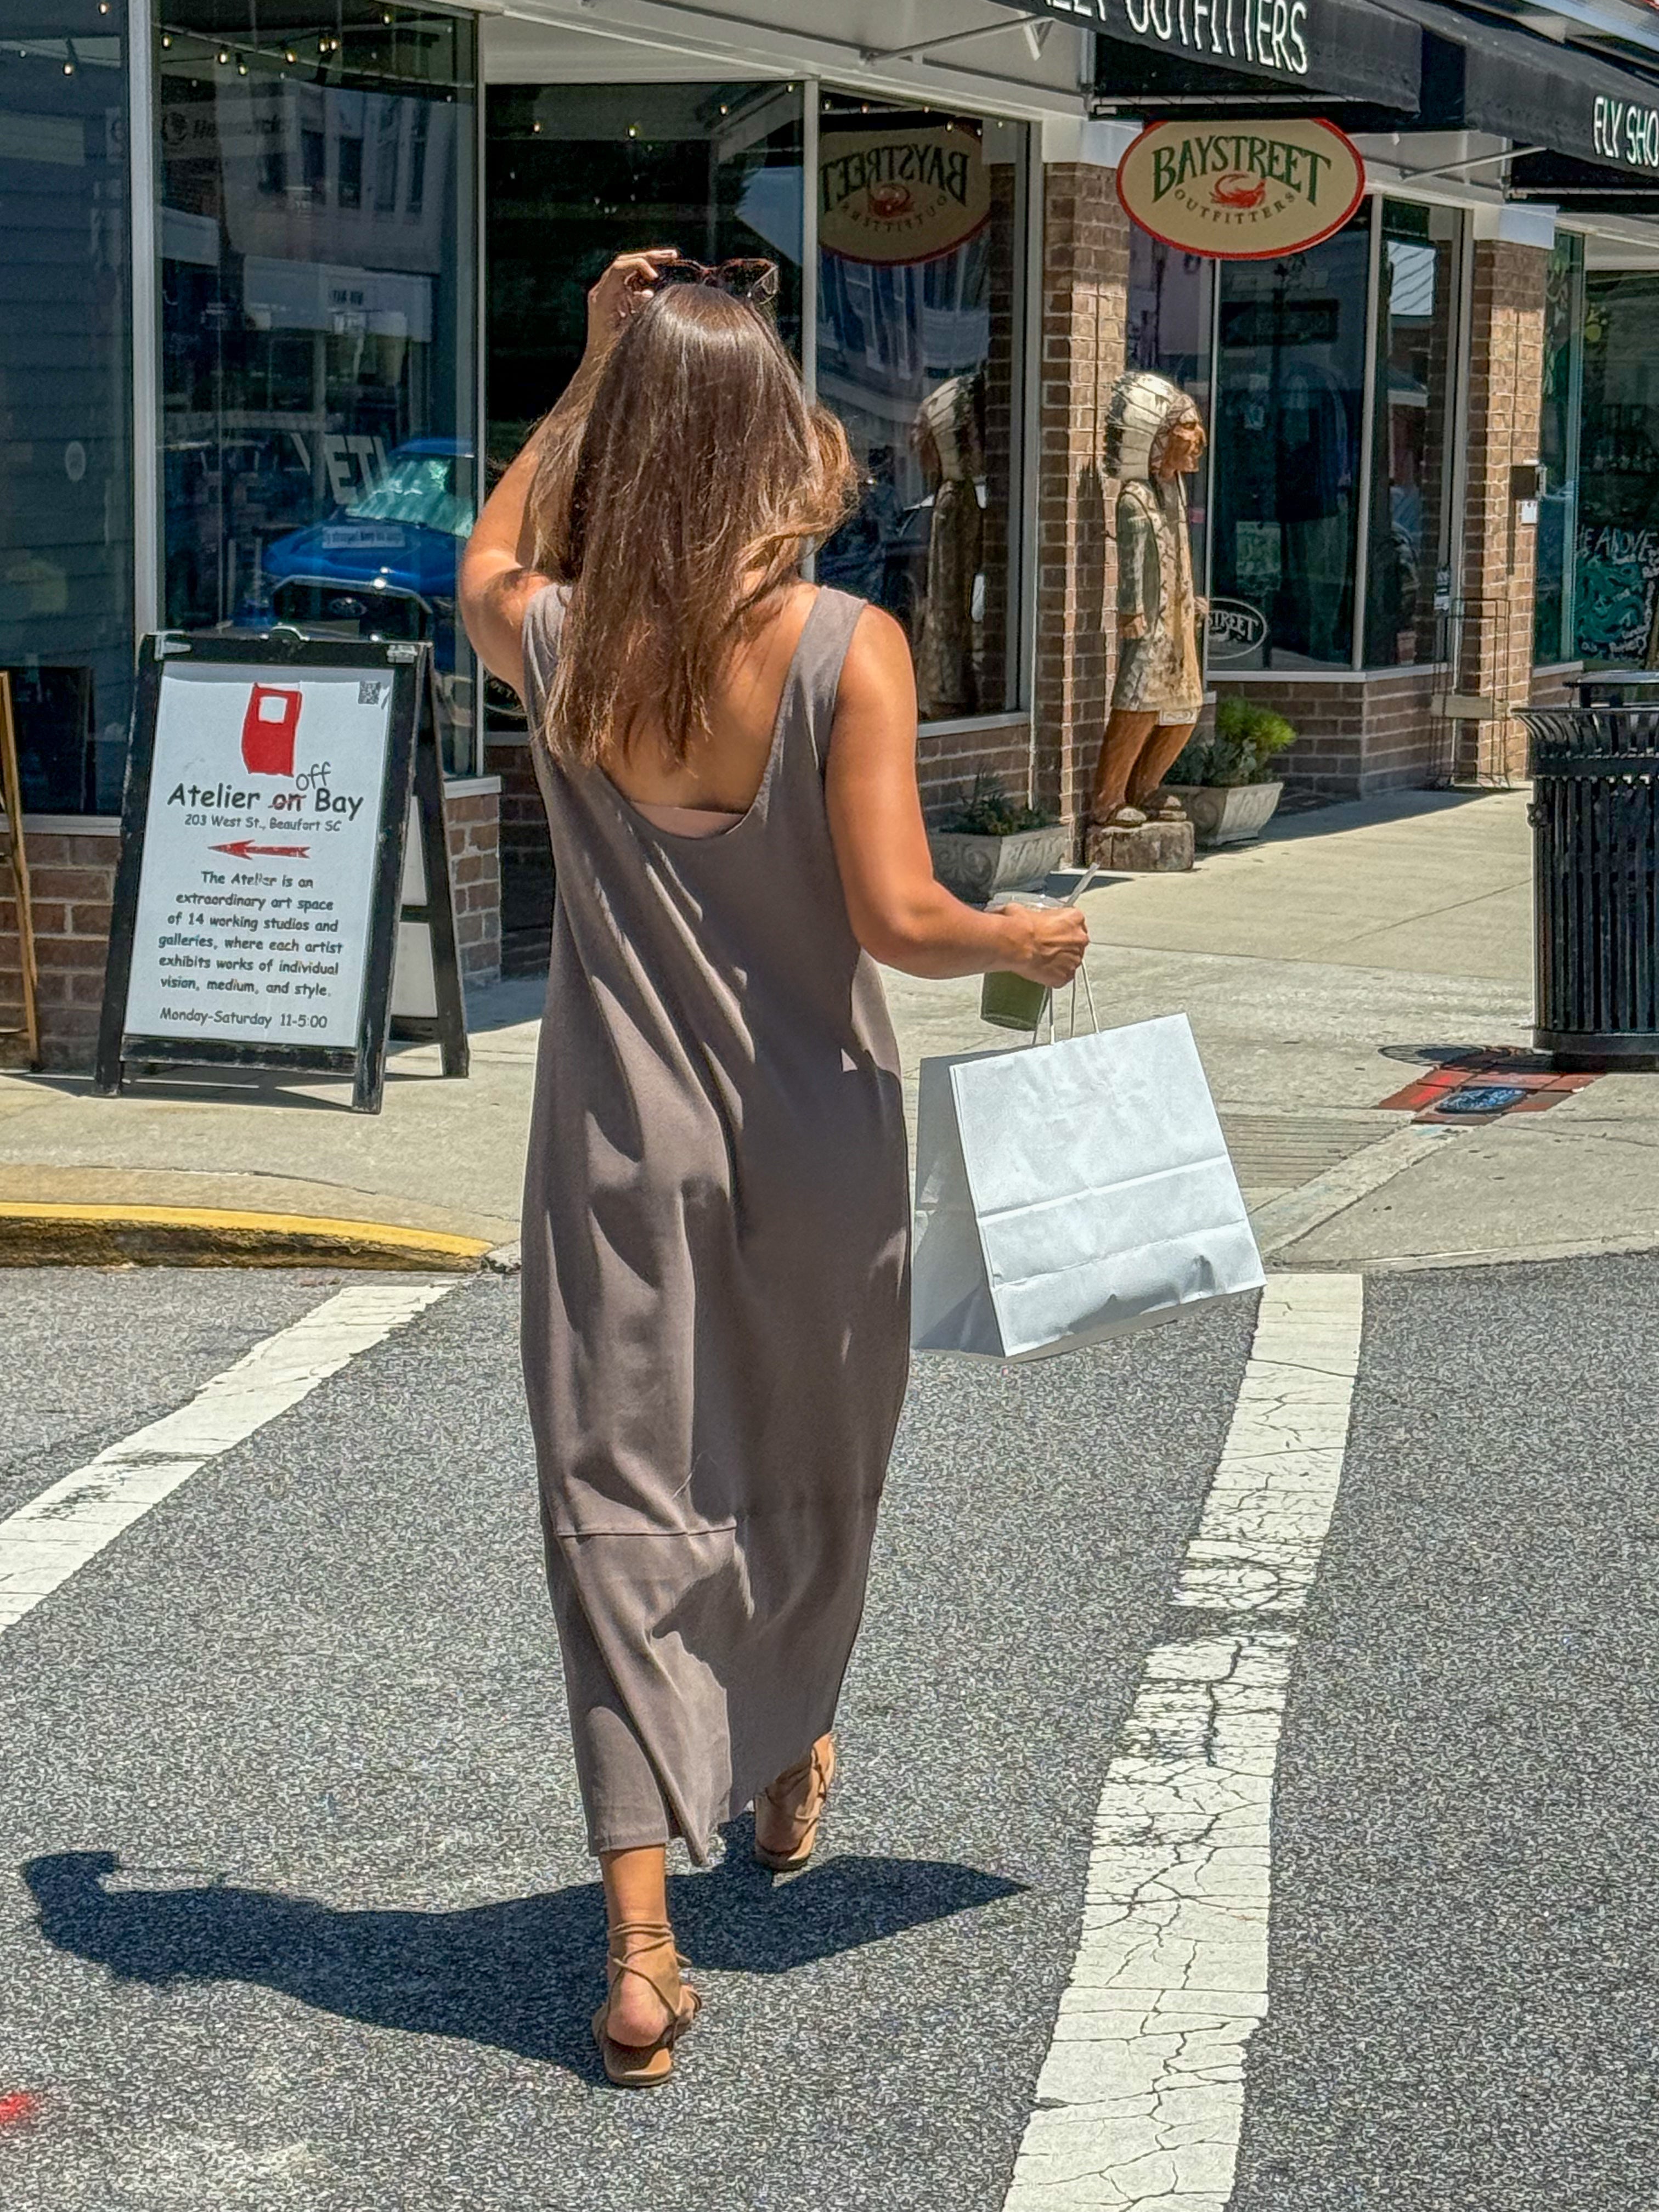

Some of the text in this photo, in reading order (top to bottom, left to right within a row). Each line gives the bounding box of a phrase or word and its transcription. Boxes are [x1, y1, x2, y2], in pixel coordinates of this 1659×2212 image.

[1594, 96, 1623, 159] FLY
[1152, 134, 1331, 207] BAYSTREET
[1174, 188, 1295, 224] OUTFITTERS
[296, 761, 331, 791] off
[167, 782, 260, 810] Atelier
[315, 788, 363, 821] Bay
[185, 814, 206, 826] 203
[211, 815, 241, 827] West
[269, 817, 320, 831] Beaufort
[325, 821, 342, 832] SC
[201, 871, 313, 888] The Atelier is an
[176, 893, 334, 913] extraordinary art space
[167, 911, 338, 932] of 14 working studios and
[159, 933, 343, 954] galleries, where each artist
[159, 954, 338, 975] exhibits works of individual
[161, 975, 331, 999] vision, medium, and style.
[159, 1007, 328, 1029] Monday-Saturday 11-5:00
